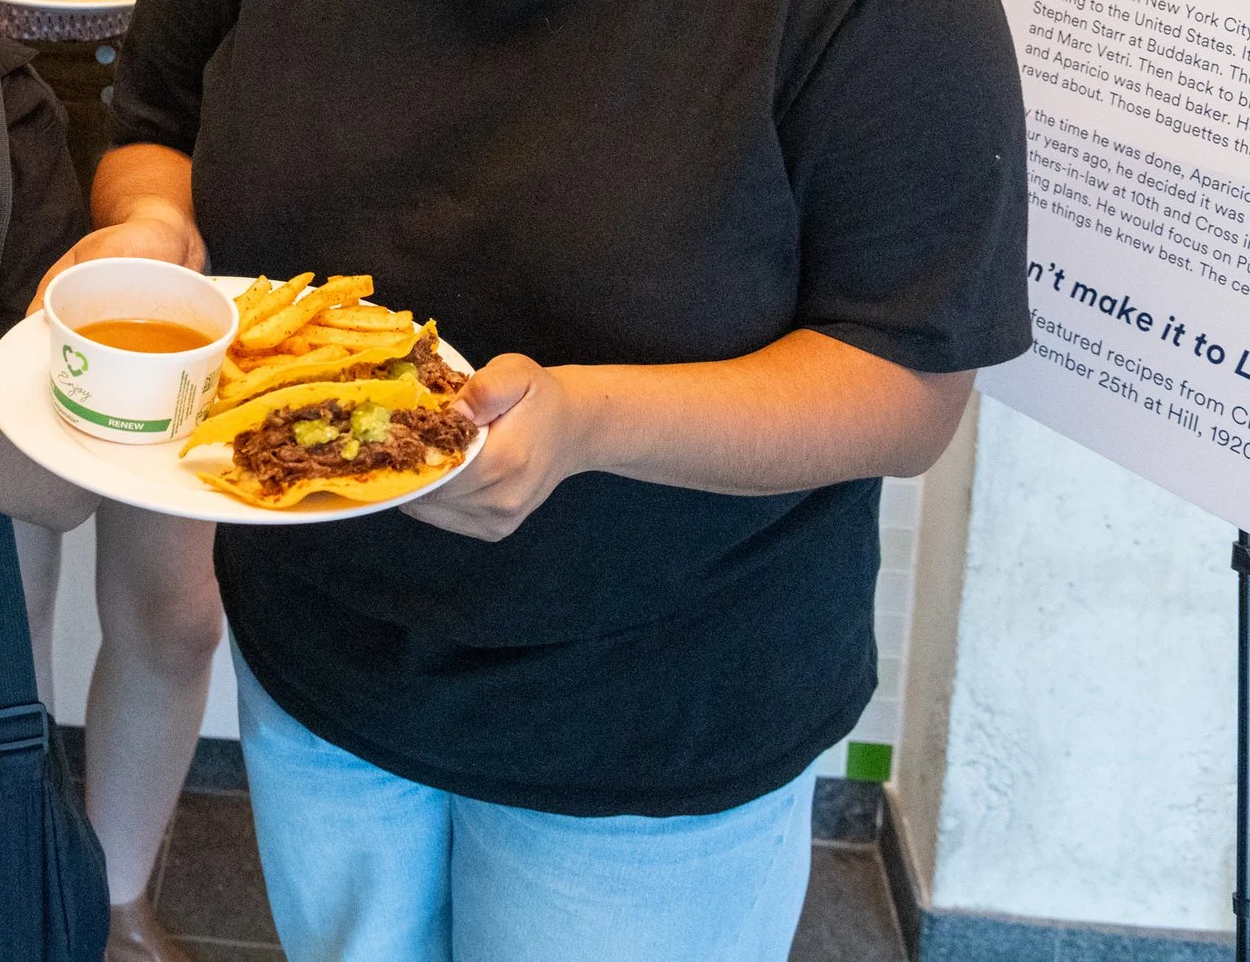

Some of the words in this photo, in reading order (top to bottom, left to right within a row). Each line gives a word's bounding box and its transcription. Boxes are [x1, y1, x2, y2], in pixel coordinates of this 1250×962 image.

[1033, 0, 1087, 30] Stephen
[1091, 20, 1125, 42] Starr
[1129, 35, 1143, 49] at
[1147, 38, 1223, 76] Buddakan.
[1230, 64, 1250, 84] Th
[1090, 0, 1103, 13] to
[1108, 4, 1130, 21] the
[1135, 11, 1182, 38] United
[1185, 28, 1236, 56] States.
[1185, 4, 1219, 27] York
[1025, 44, 1050, 60] and
[1053, 52, 1109, 81] Aparicio
[1114, 74, 1141, 93] was
[1145, 83, 1181, 107] head
[1185, 97, 1231, 125] baker.
[1029, 24, 1054, 39] and
[1057, 30, 1092, 53] Marc
[1097, 43, 1132, 68] Vetri.
[1138, 57, 1173, 81] Then
[1178, 71, 1213, 95] back
[1218, 87, 1233, 102] to
[1022, 64, 1059, 85] raved
[1061, 78, 1103, 102] about.
[1110, 91, 1151, 119] Those
[1155, 109, 1229, 148] baguettes
[1035, 110, 1055, 126] the
[1059, 119, 1088, 139] time
[1092, 130, 1109, 147] he
[1113, 141, 1141, 160] was
[1145, 152, 1184, 178] done,
[1027, 129, 1040, 142] ur
[1044, 136, 1079, 158] years
[1082, 152, 1112, 173] ago,
[1115, 161, 1133, 179] he
[1137, 172, 1196, 204] decided
[1200, 193, 1210, 210] it
[1215, 203, 1245, 223] was
[1027, 150, 1109, 190] thers-in-law
[1112, 185, 1126, 199] at
[1131, 191, 1159, 212] 10th
[1163, 206, 1191, 224] and
[1195, 216, 1238, 244] Cross
[1027, 170, 1050, 191] ing
[1053, 182, 1091, 207] plans.
[1096, 197, 1116, 217] He
[1120, 210, 1164, 236] would
[1168, 227, 1208, 255] focus
[1213, 249, 1231, 265] on
[1051, 200, 1092, 228] things
[1095, 218, 1112, 237] he
[1116, 228, 1154, 254] knew
[1158, 245, 1193, 272] best.
[1199, 260, 1227, 286] The
[1030, 309, 1103, 357] featured
[1106, 349, 1174, 391] recipes
[1179, 380, 1224, 416] from
[1070, 282, 1153, 332] make
[1161, 316, 1185, 347] it
[1193, 333, 1225, 365] to
[108, 419, 145, 431] RENEW
[1032, 338, 1094, 380] tember
[1099, 371, 1138, 403] 25th
[1144, 396, 1162, 415] at
[1168, 403, 1202, 437] Hill,
